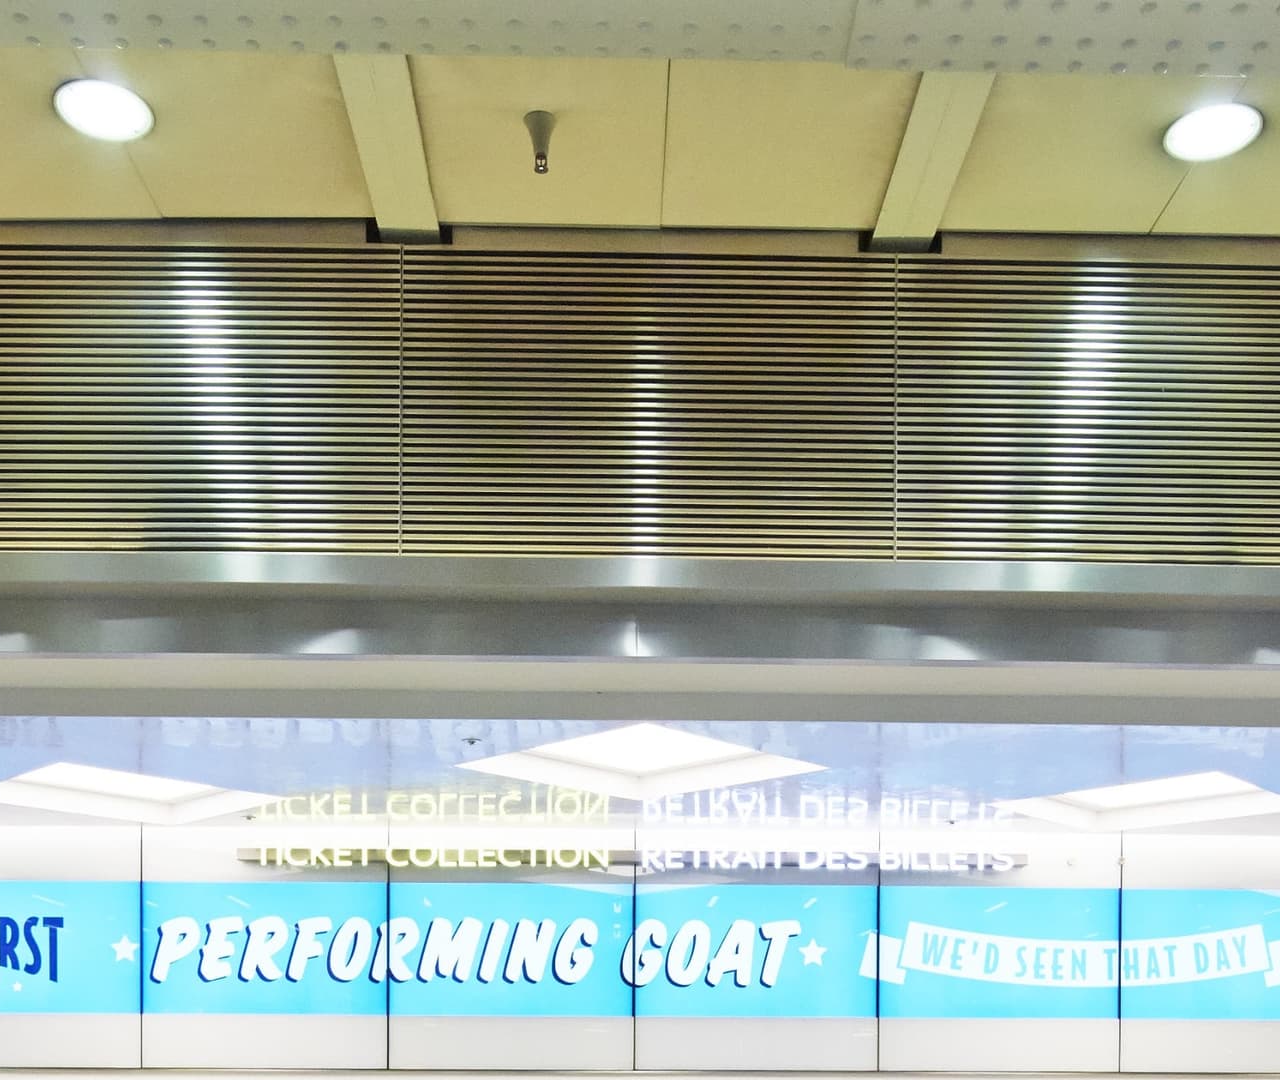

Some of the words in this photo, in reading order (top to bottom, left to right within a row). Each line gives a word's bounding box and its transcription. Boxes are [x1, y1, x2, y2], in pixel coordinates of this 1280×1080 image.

[258, 842, 370, 867] TICKET
[385, 843, 609, 869] COLLECTION
[641, 845, 784, 871] RETRAIT
[799, 846, 869, 871] DES
[879, 847, 1013, 872] BILLETS
[149, 914, 599, 986] PERFORMING
[620, 918, 803, 989] GOAT
[920, 932, 1001, 975] WE'D
[1014, 945, 1088, 982] SEEN
[1103, 944, 1178, 981] THAT
[1192, 934, 1249, 973] DAY
